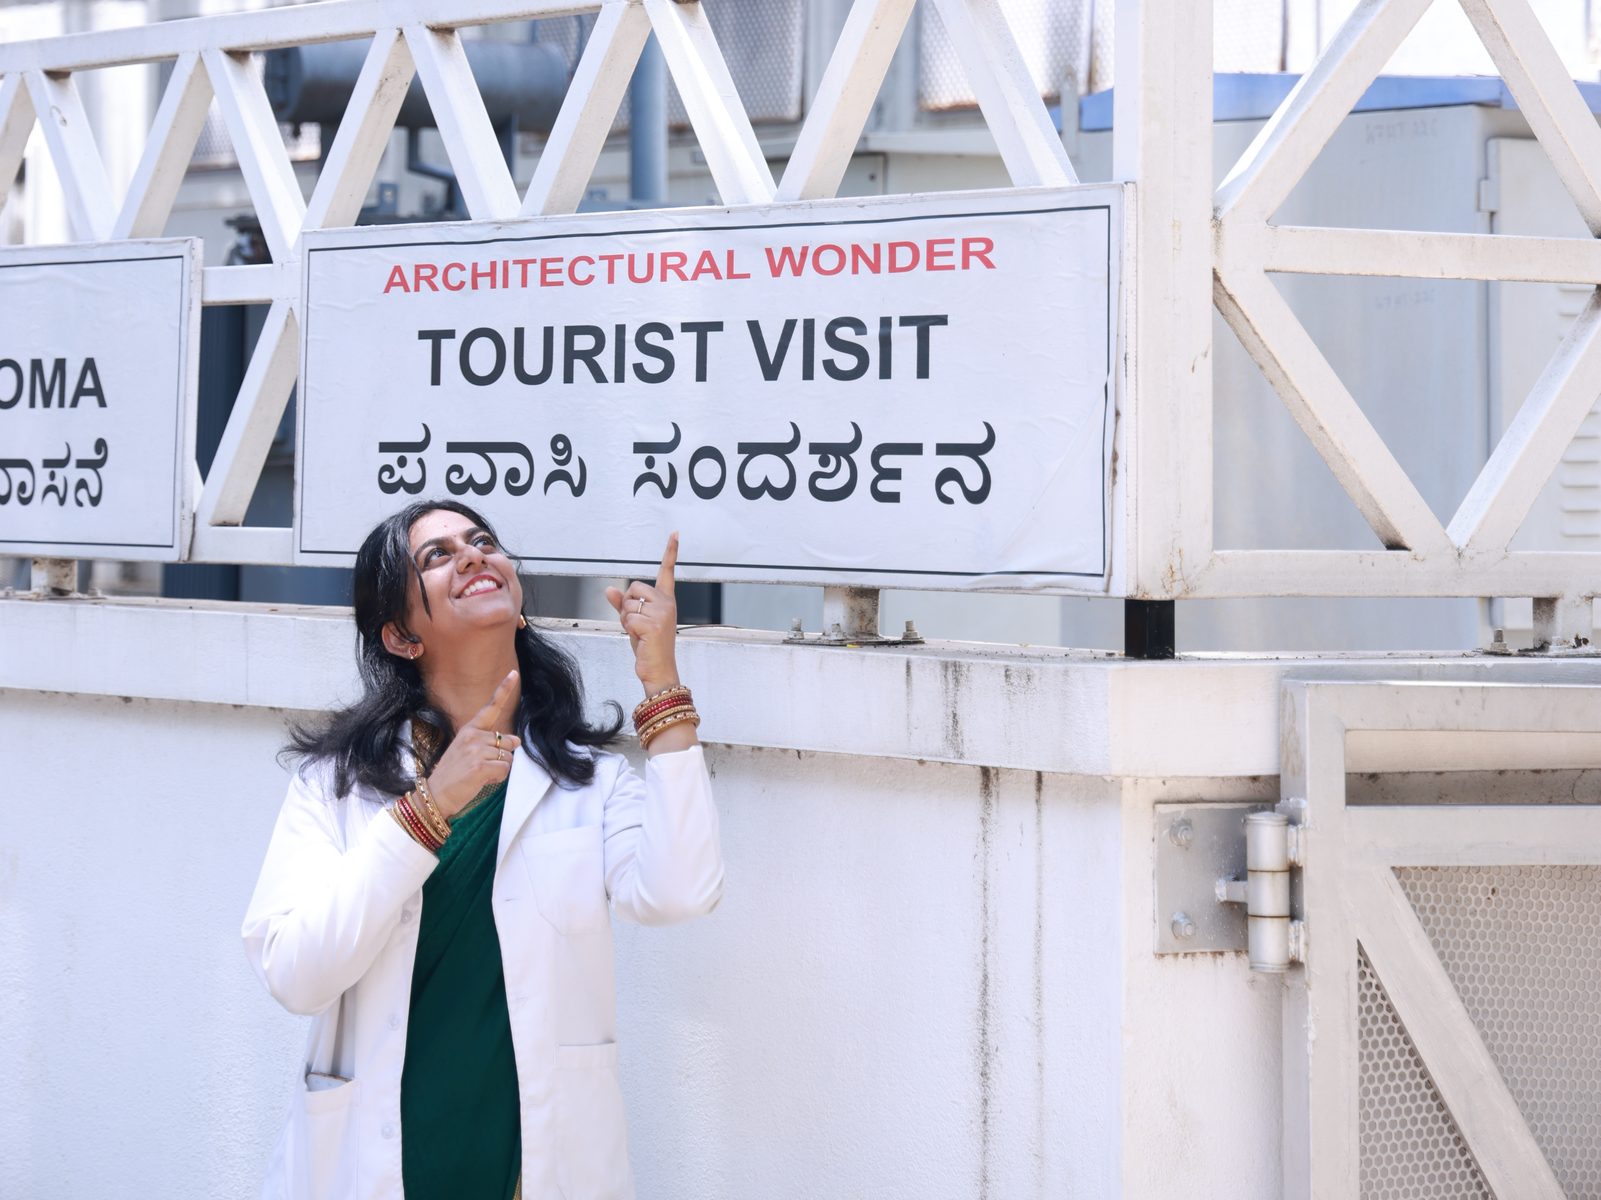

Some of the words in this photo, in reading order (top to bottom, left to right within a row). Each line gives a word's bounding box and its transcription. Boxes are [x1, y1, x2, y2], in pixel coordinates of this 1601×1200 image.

[383, 250, 750, 293] ARCHITECTURAL
[765, 238, 996, 277] WONDER
[418, 321, 723, 386] TOURIST
[746, 315, 948, 381] VISIT
[0, 358, 107, 409] OMA
[633, 421, 995, 504] ಸಂದರ್ಶನ
